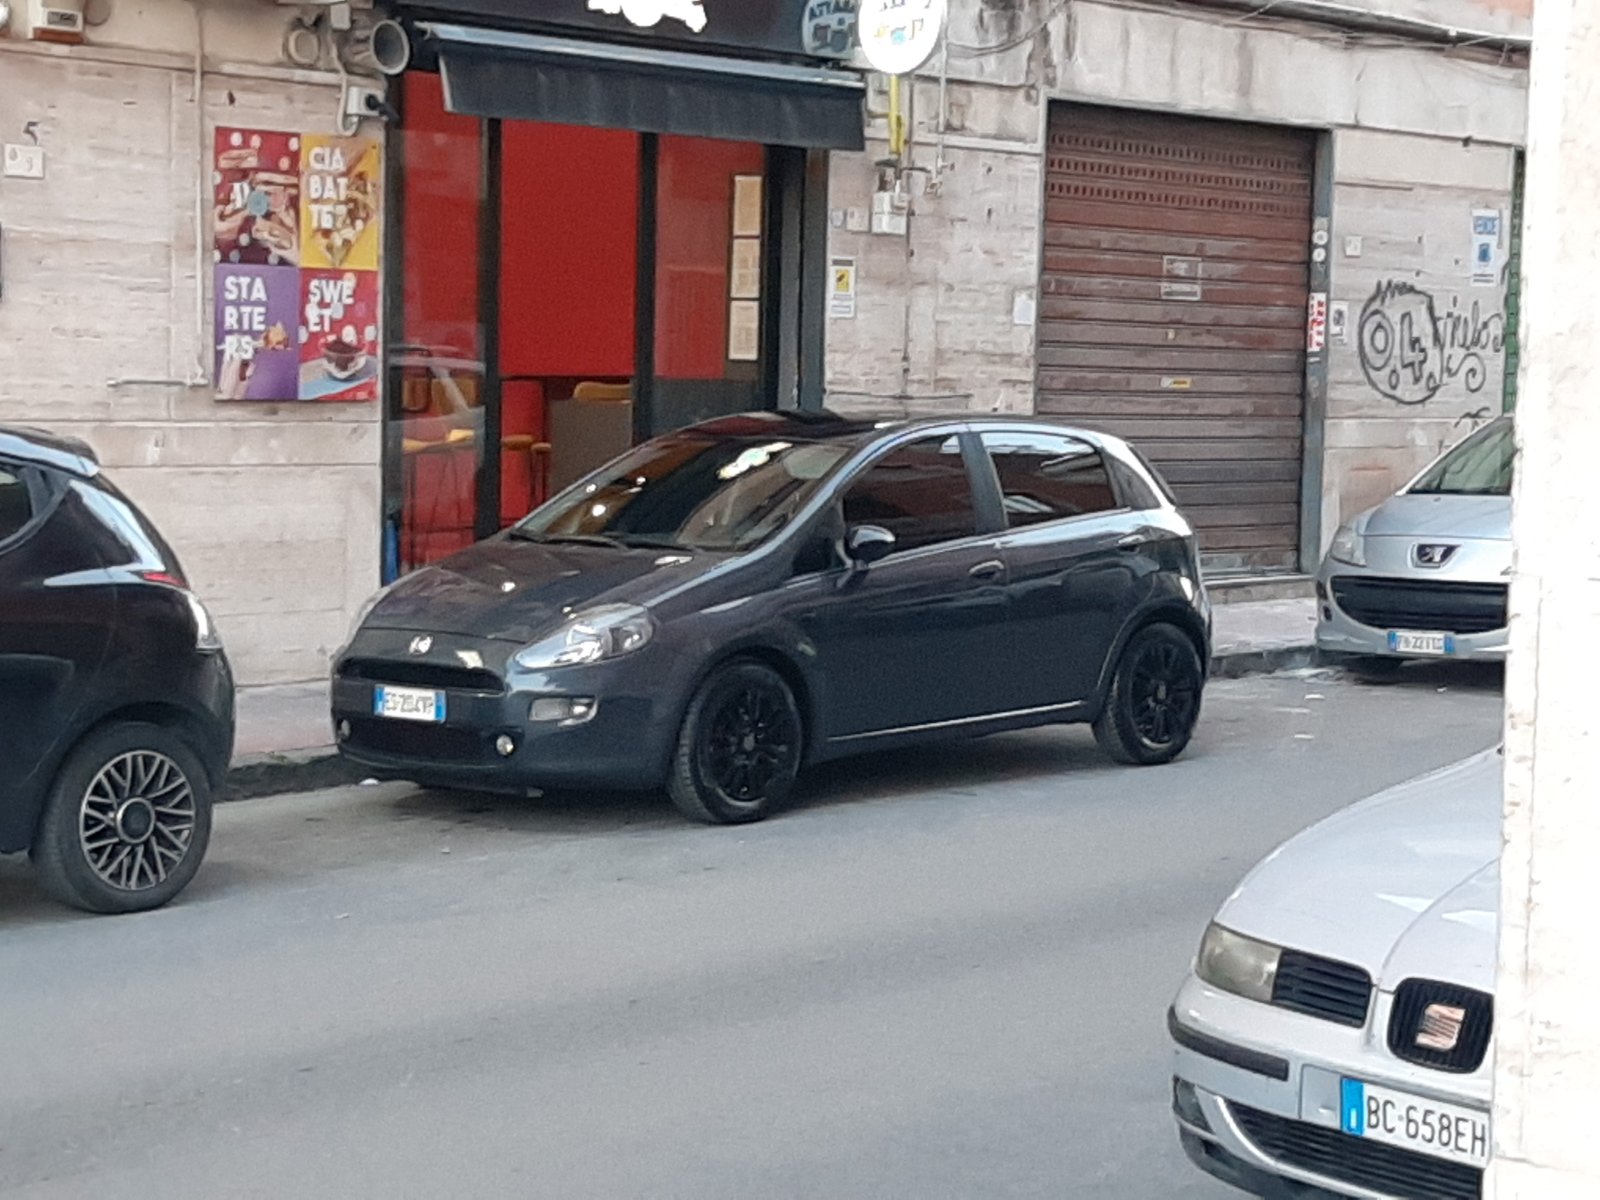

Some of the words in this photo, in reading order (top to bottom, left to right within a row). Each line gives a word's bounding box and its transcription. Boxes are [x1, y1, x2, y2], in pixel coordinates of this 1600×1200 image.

[309, 146, 348, 172] CIA
[309, 174, 349, 201] BAT
[224, 275, 268, 302] STA
[309, 279, 355, 305] SWE
[224, 306, 267, 332] RTE
[309, 306, 332, 333] ET
[224, 335, 255, 362] RS
